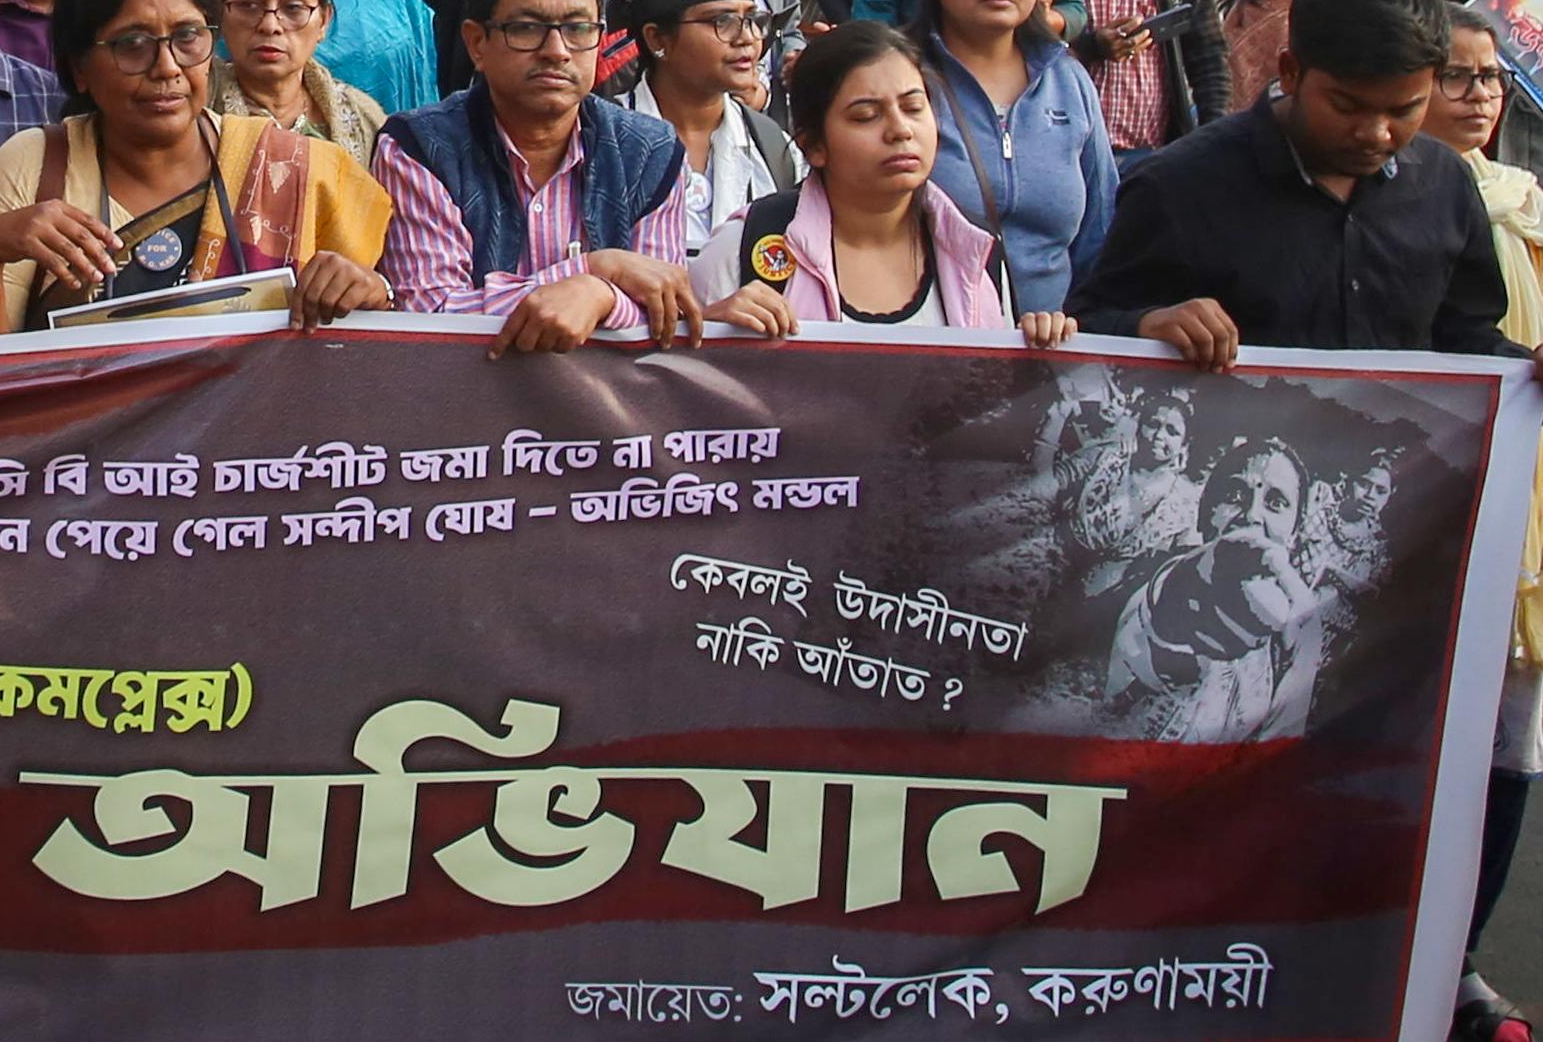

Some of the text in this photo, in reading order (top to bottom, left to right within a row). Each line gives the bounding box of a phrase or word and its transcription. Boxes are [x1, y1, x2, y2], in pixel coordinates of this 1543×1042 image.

[43, 453, 88, 496] বি
[103, 453, 201, 500] আই
[213, 440, 387, 494] চার্জশীট
[401, 444, 489, 484] জমা
[502, 428, 601, 478] দিতে
[612, 433, 653, 471] না
[663, 425, 782, 472] পারায়
[44, 516, 159, 562] পেয়ে
[171, 514, 267, 558] গেল
[282, 496, 412, 549] সন্দীপ
[425, 496, 516, 544] ঘোষ
[570, 477, 740, 526] অভিজিৎ
[751, 474, 860, 514] মন্ডল
[667, 550, 1029, 664] কেবলই উদাসীনতা
[694, 616, 784, 671] নাকি
[793, 636, 932, 702] আঁতাত
[18, 698, 1127, 916] অভিযান
[563, 941, 1274, 1028] জমায়েত: সল্টলেক, করুণাময়ী
